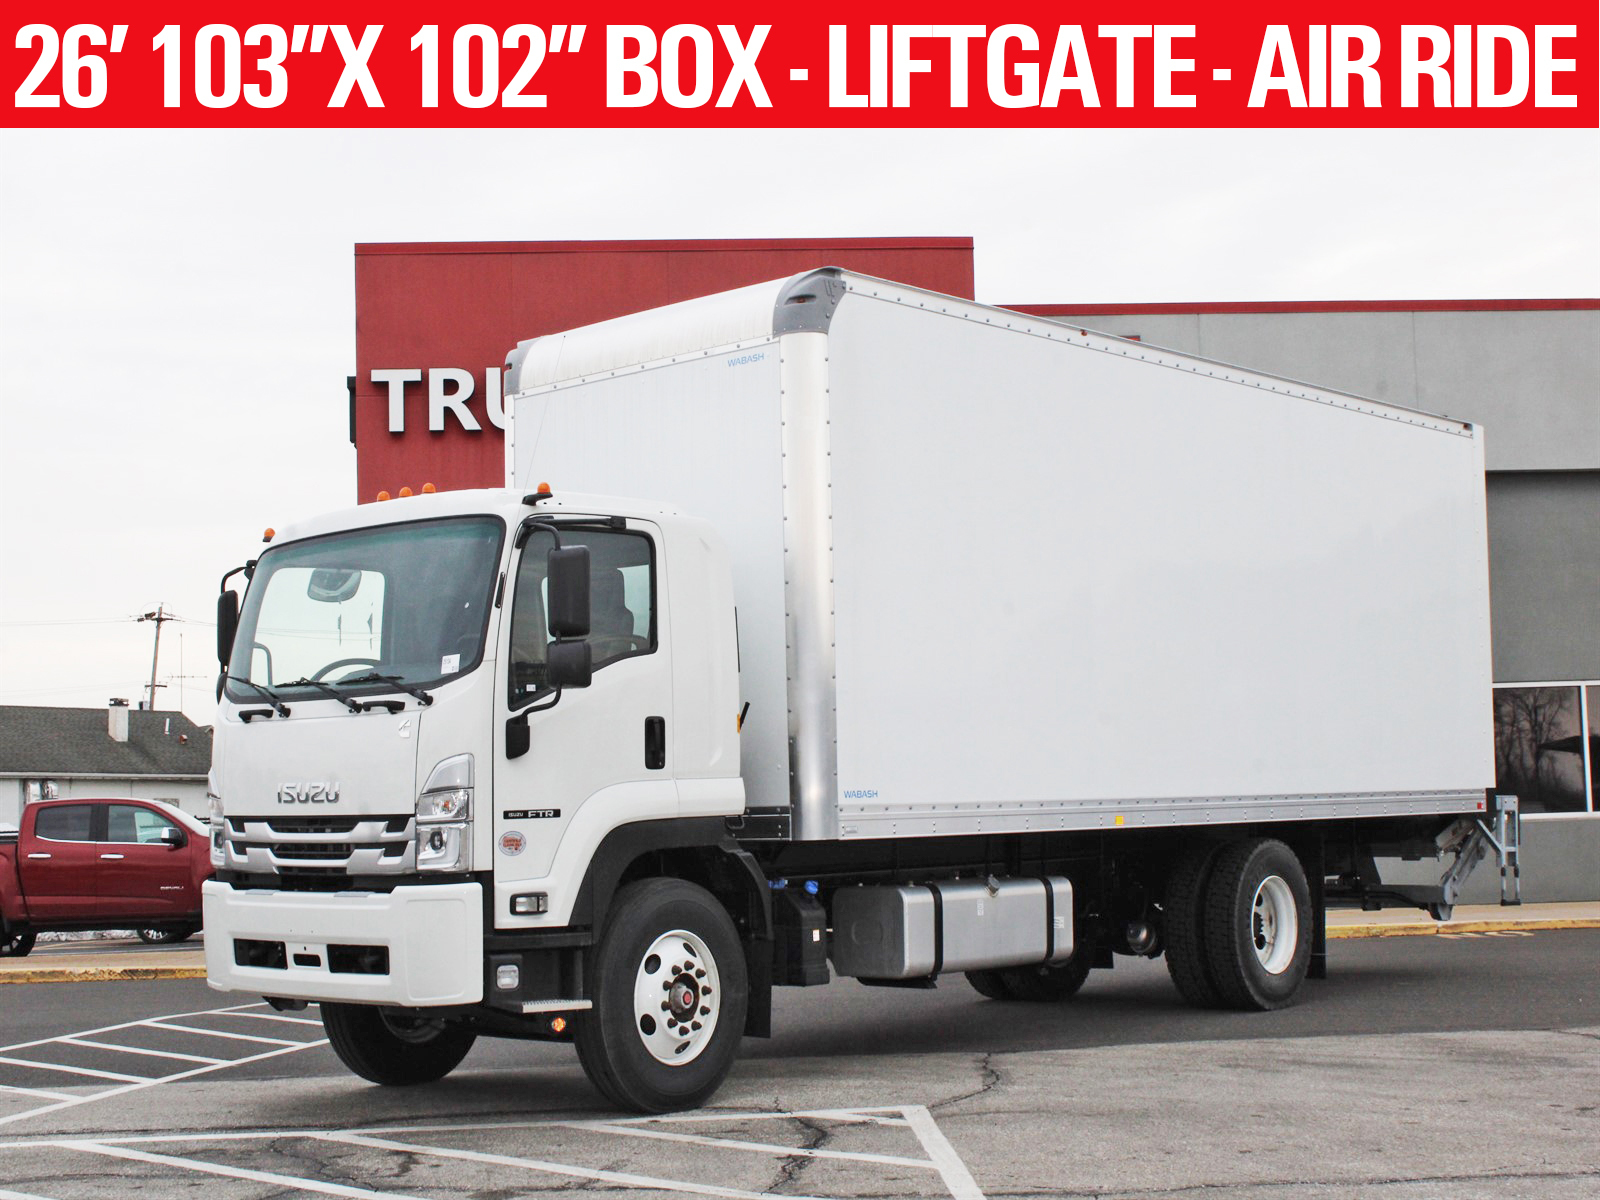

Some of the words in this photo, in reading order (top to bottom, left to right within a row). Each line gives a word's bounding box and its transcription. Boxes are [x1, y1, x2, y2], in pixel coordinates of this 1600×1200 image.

[727, 352, 765, 367] WABASH
[277, 782, 340, 804] ISUZU
[843, 790, 878, 799] WABASH
[528, 810, 554, 818] FTR
